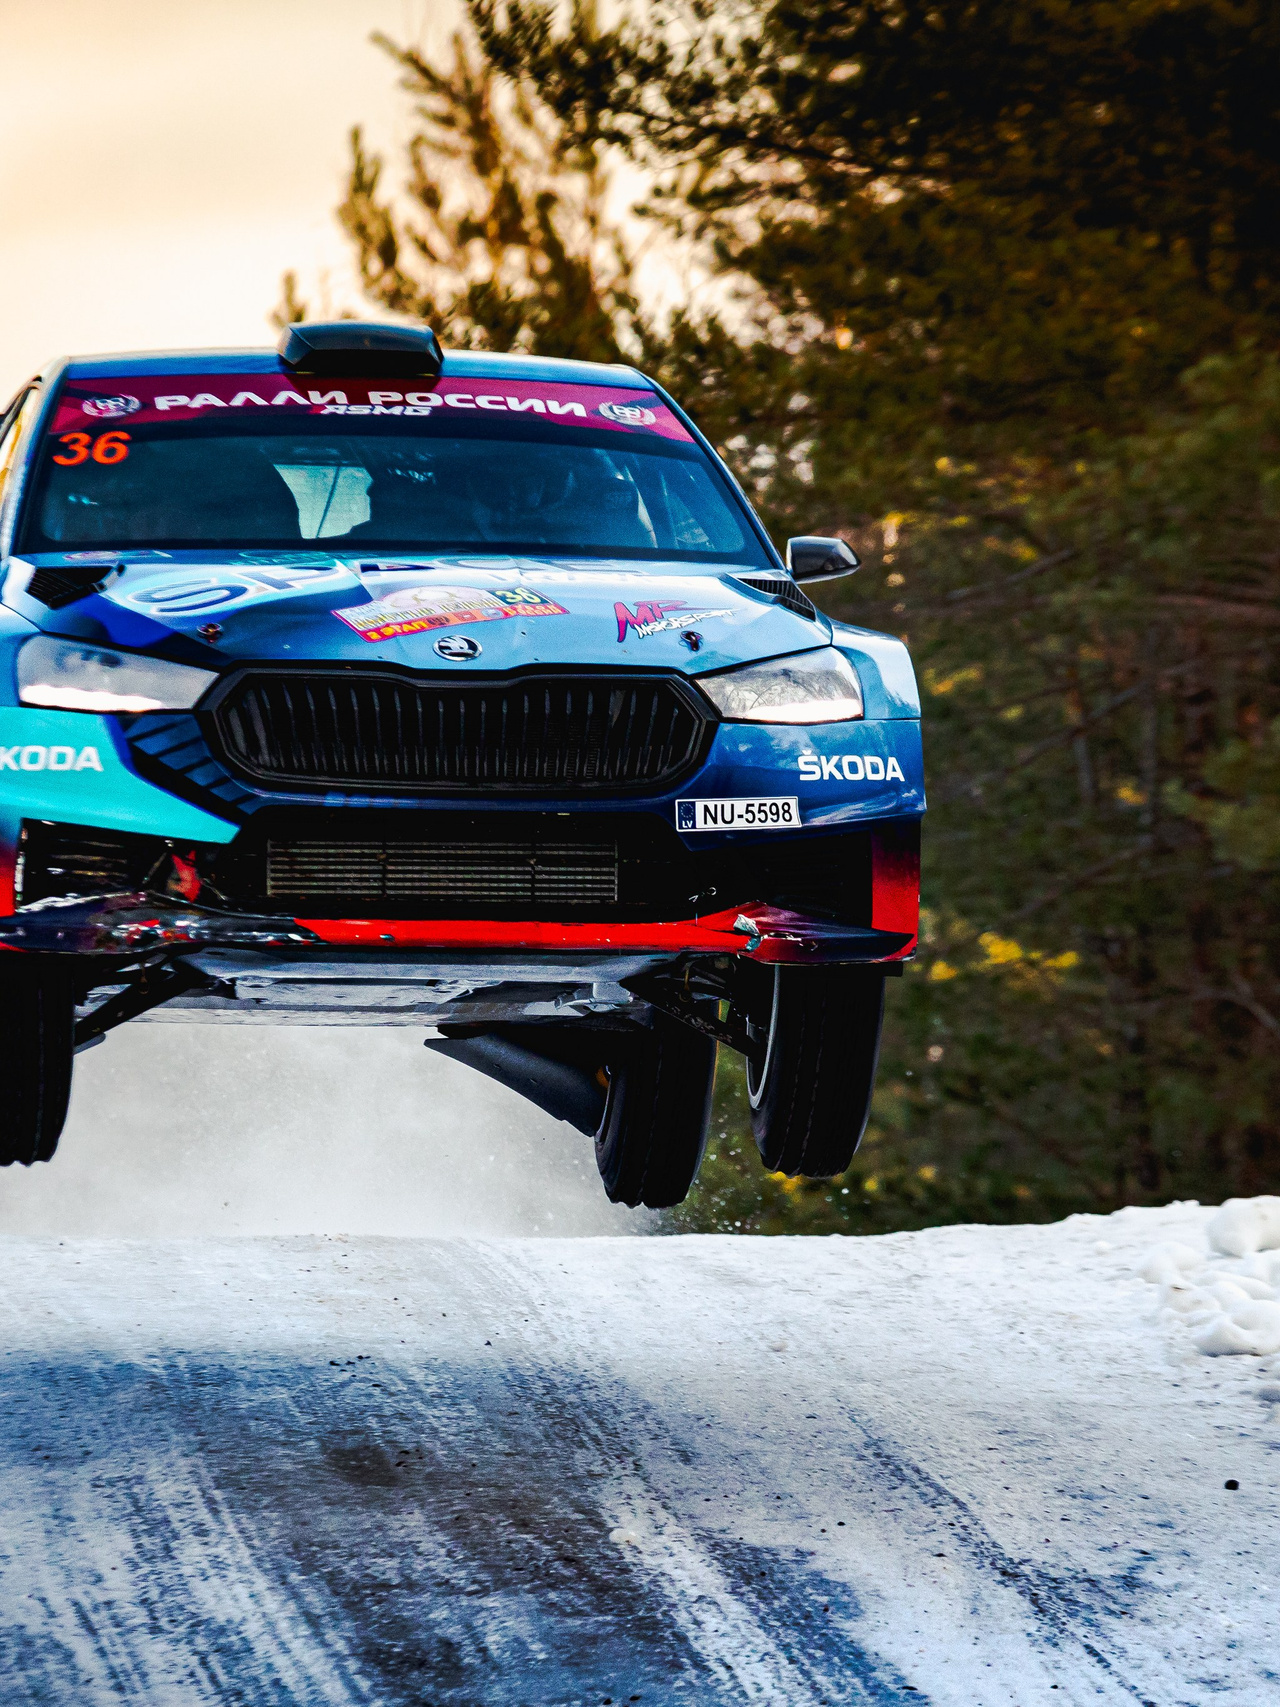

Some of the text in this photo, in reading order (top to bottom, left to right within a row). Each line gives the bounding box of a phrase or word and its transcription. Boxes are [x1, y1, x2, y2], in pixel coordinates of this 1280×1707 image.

[154, 390, 588, 417] РАЛЛИ РОССИИ
[52, 431, 132, 466] 36
[495, 587, 541, 605] 36
[797, 750, 906, 782] ŠKODA
[682, 820, 693, 829] LV
[703, 802, 793, 825] NU-5598
